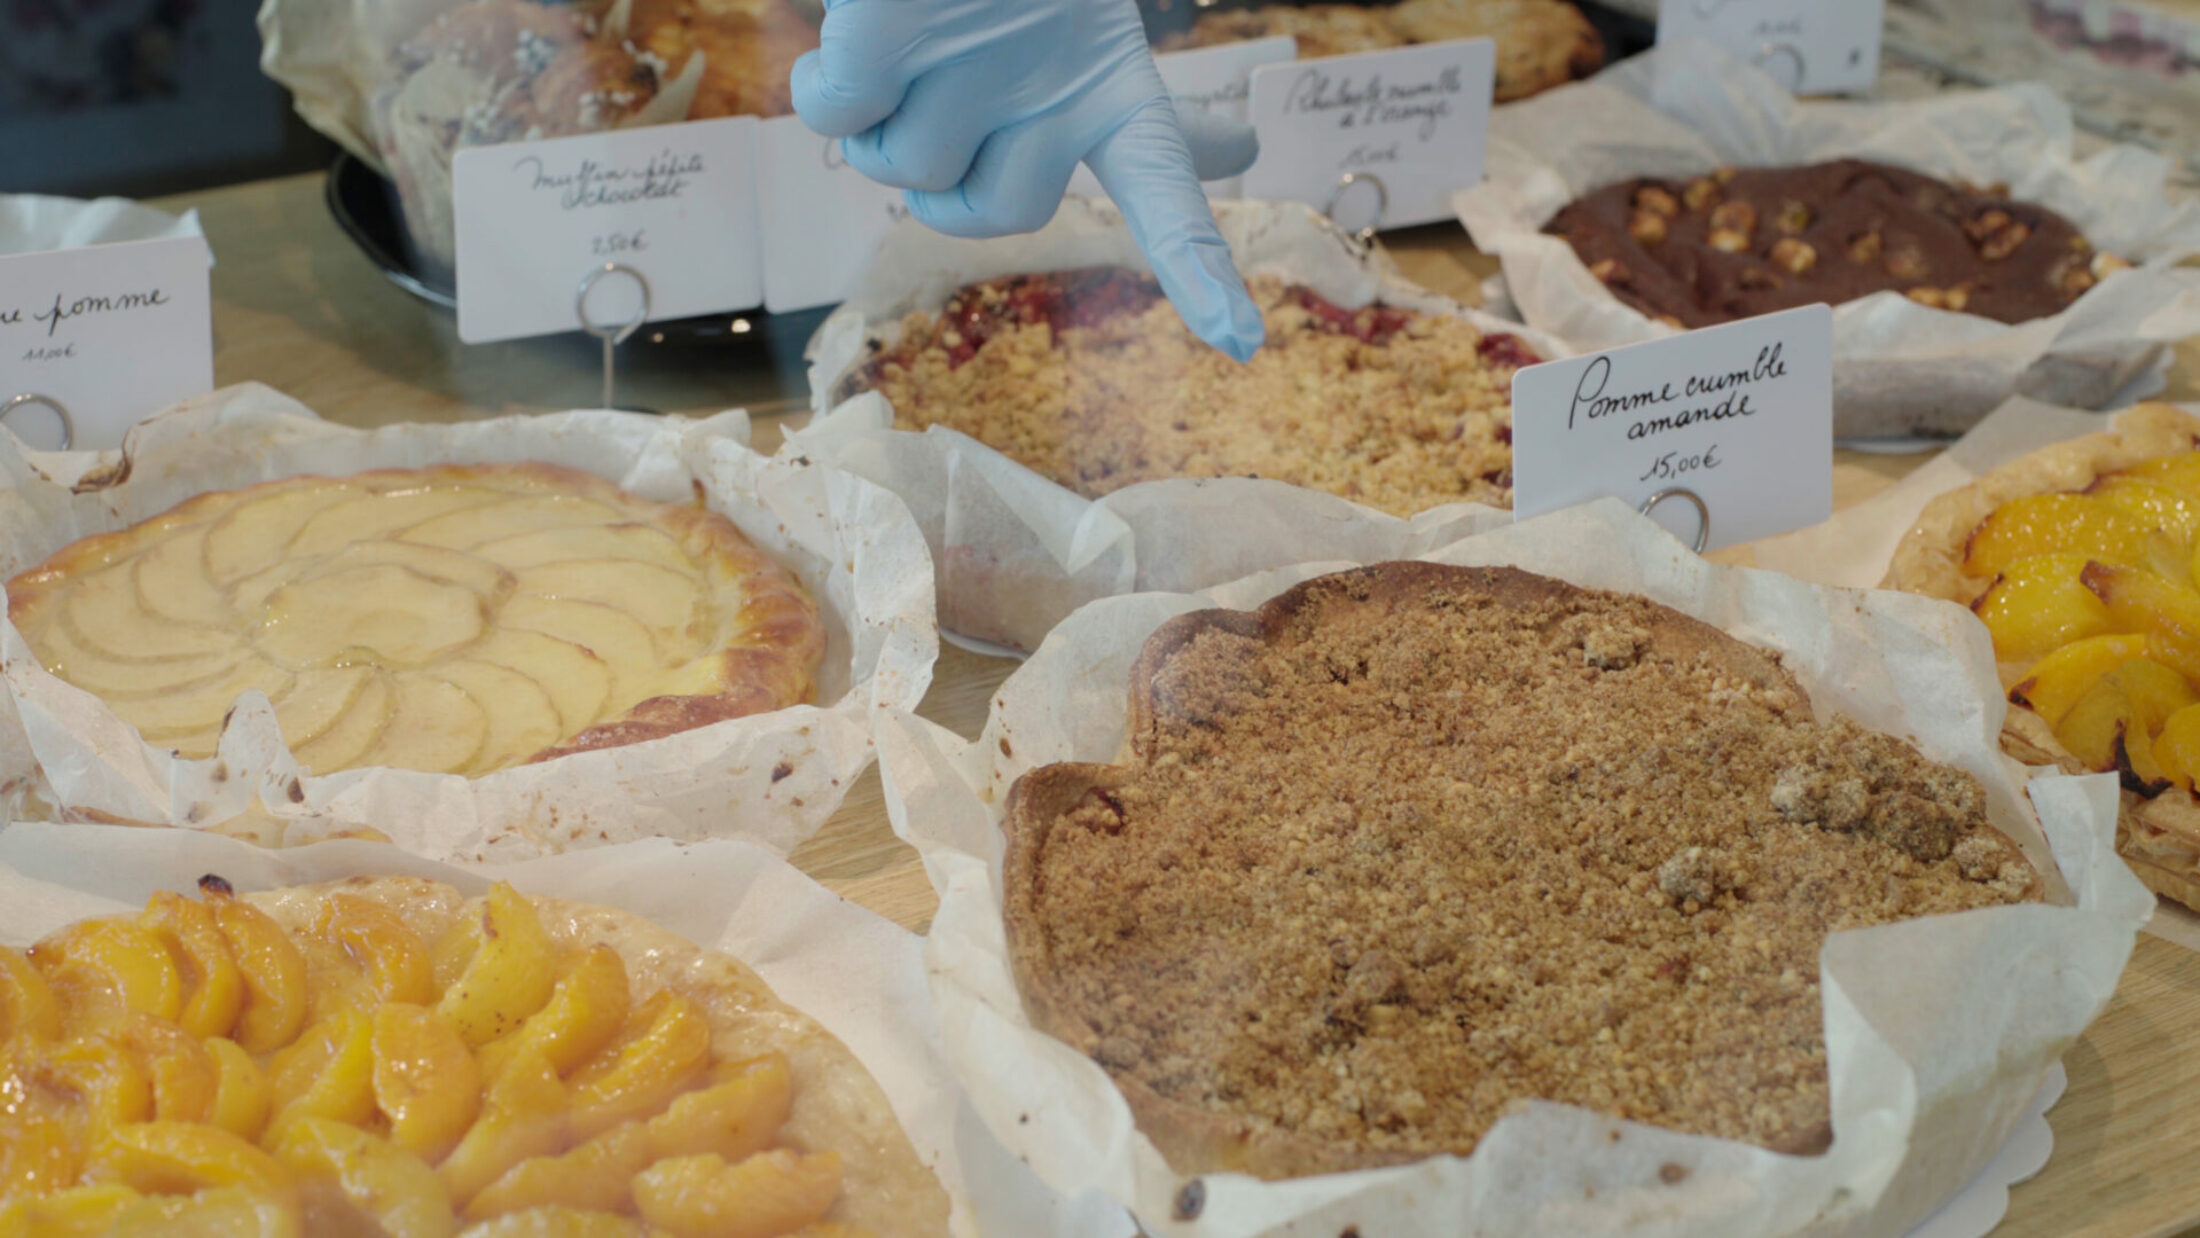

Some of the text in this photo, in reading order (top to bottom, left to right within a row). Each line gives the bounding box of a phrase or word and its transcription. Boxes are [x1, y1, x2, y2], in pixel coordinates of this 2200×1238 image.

[34, 288, 171, 338] pomme
[1568, 341, 1788, 430] Pomme crumble
[1626, 390, 1756, 440] amande
[1639, 444, 1723, 482] 15,00€
